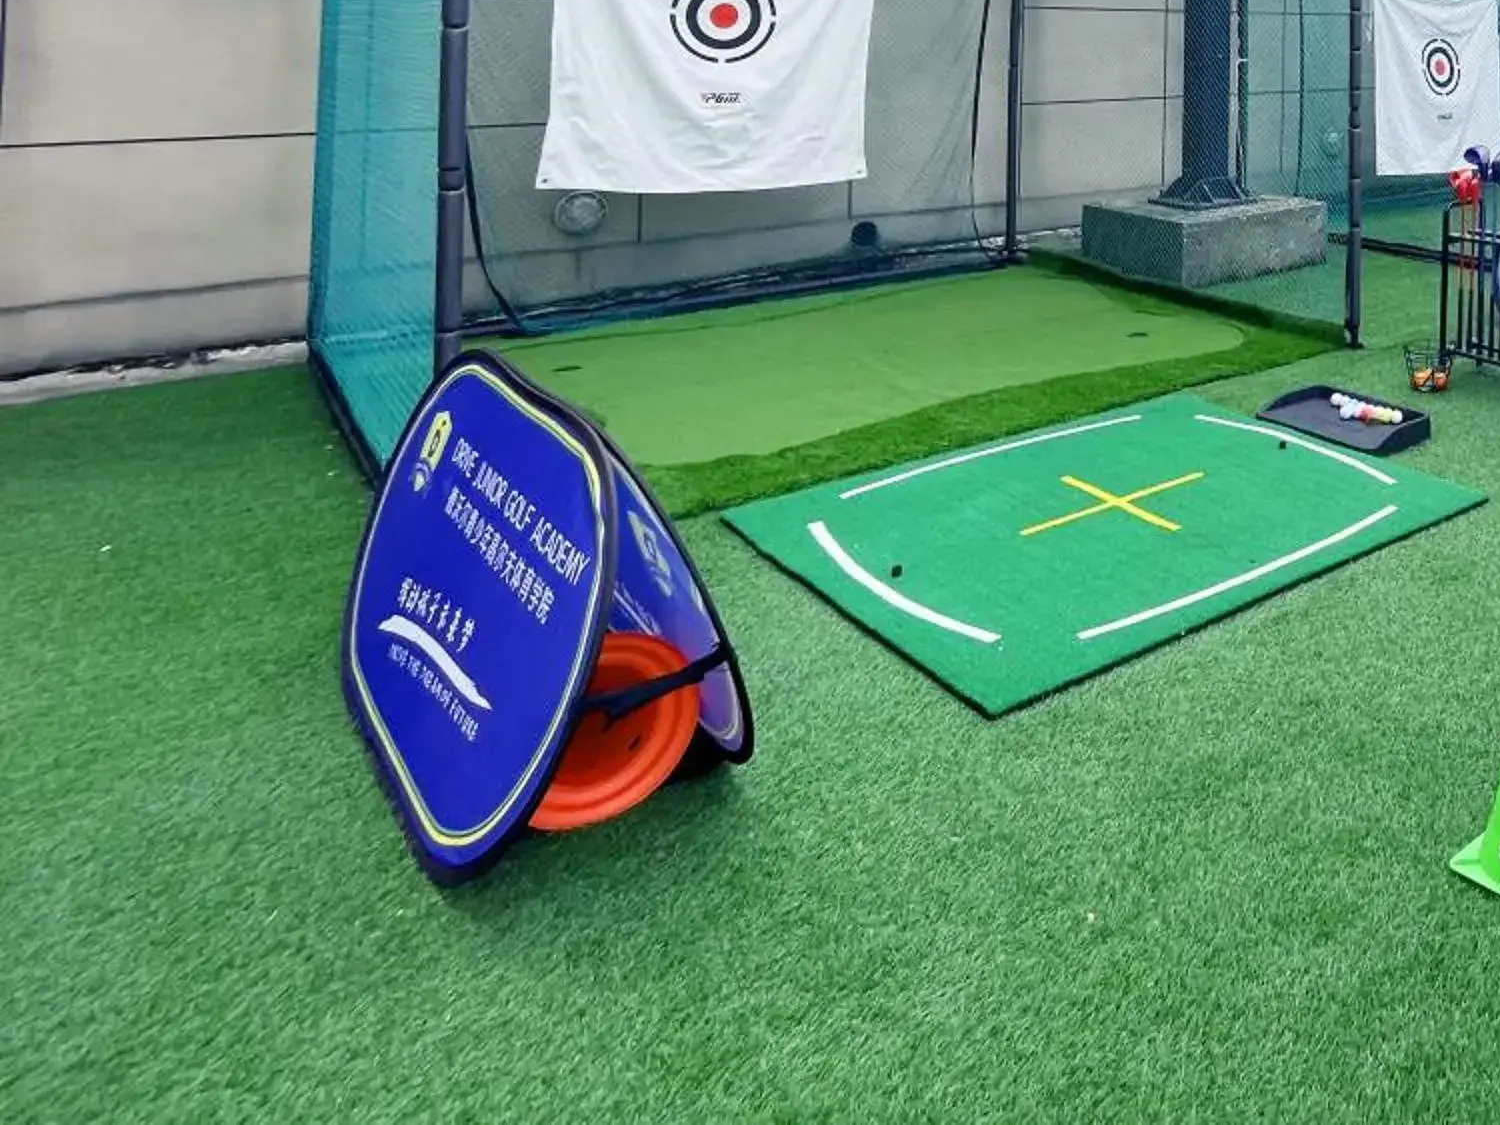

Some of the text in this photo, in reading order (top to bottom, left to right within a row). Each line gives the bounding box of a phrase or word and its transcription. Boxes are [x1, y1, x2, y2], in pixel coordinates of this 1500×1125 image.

[452, 437, 590, 586] DRIVE JUNIOR GOLF ACADEMY
